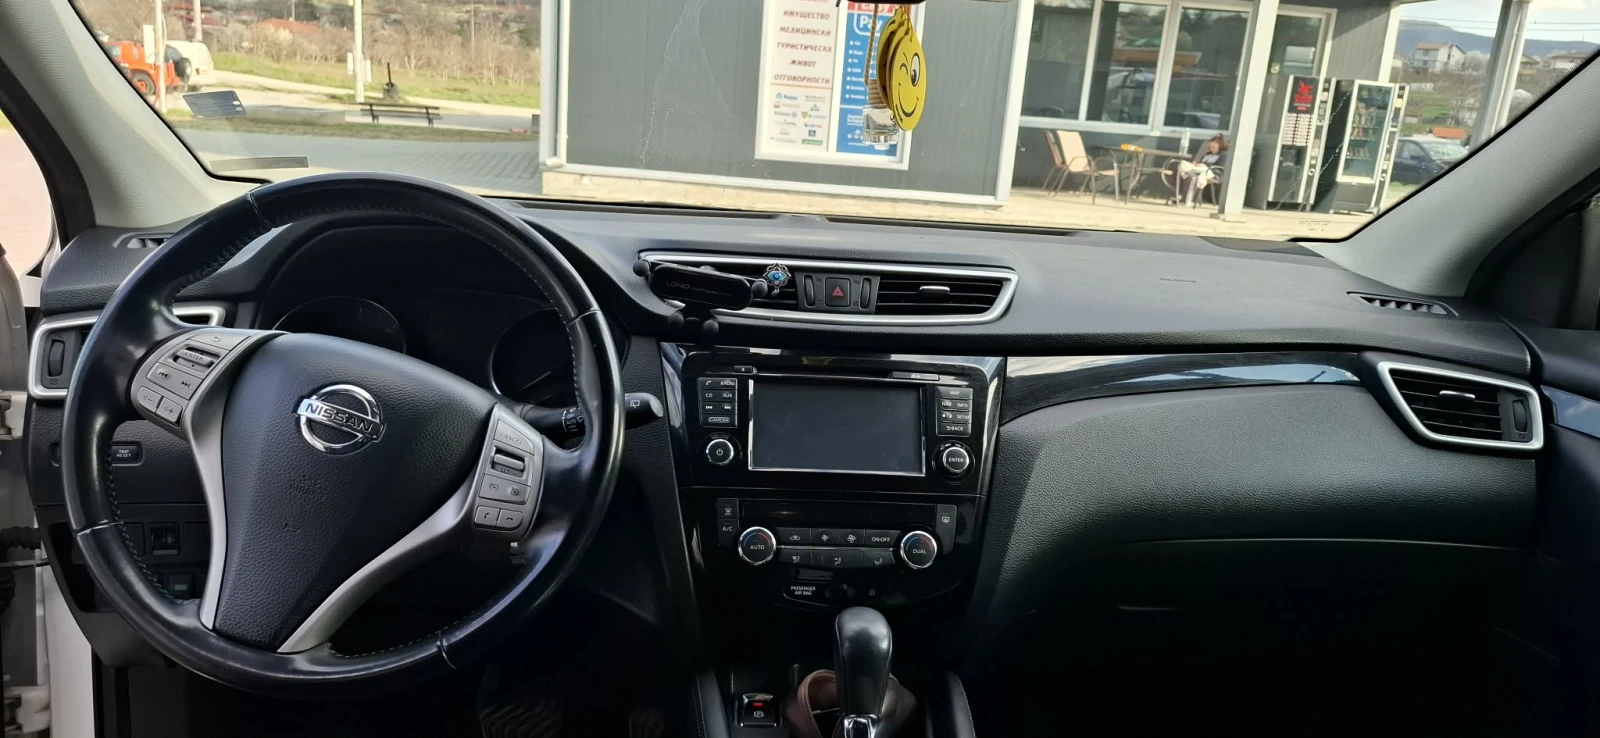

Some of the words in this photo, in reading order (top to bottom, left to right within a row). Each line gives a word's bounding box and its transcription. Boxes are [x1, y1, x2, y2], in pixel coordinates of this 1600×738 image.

[783, 10, 830, 20] ИМУЩЕСТВО
[779, 26, 831, 37] МЕДИЦИНСКИ
[777, 42, 832, 53] ТУРИСТИЧЕСКА
[790, 60, 817, 68] ЖИВОТ
[774, 74, 831, 84] ОТГОВОРНОСТИ
[184, 352, 204, 361] ENTER
[305, 403, 373, 432] NISSAN
[500, 432, 522, 445] CANCEL
